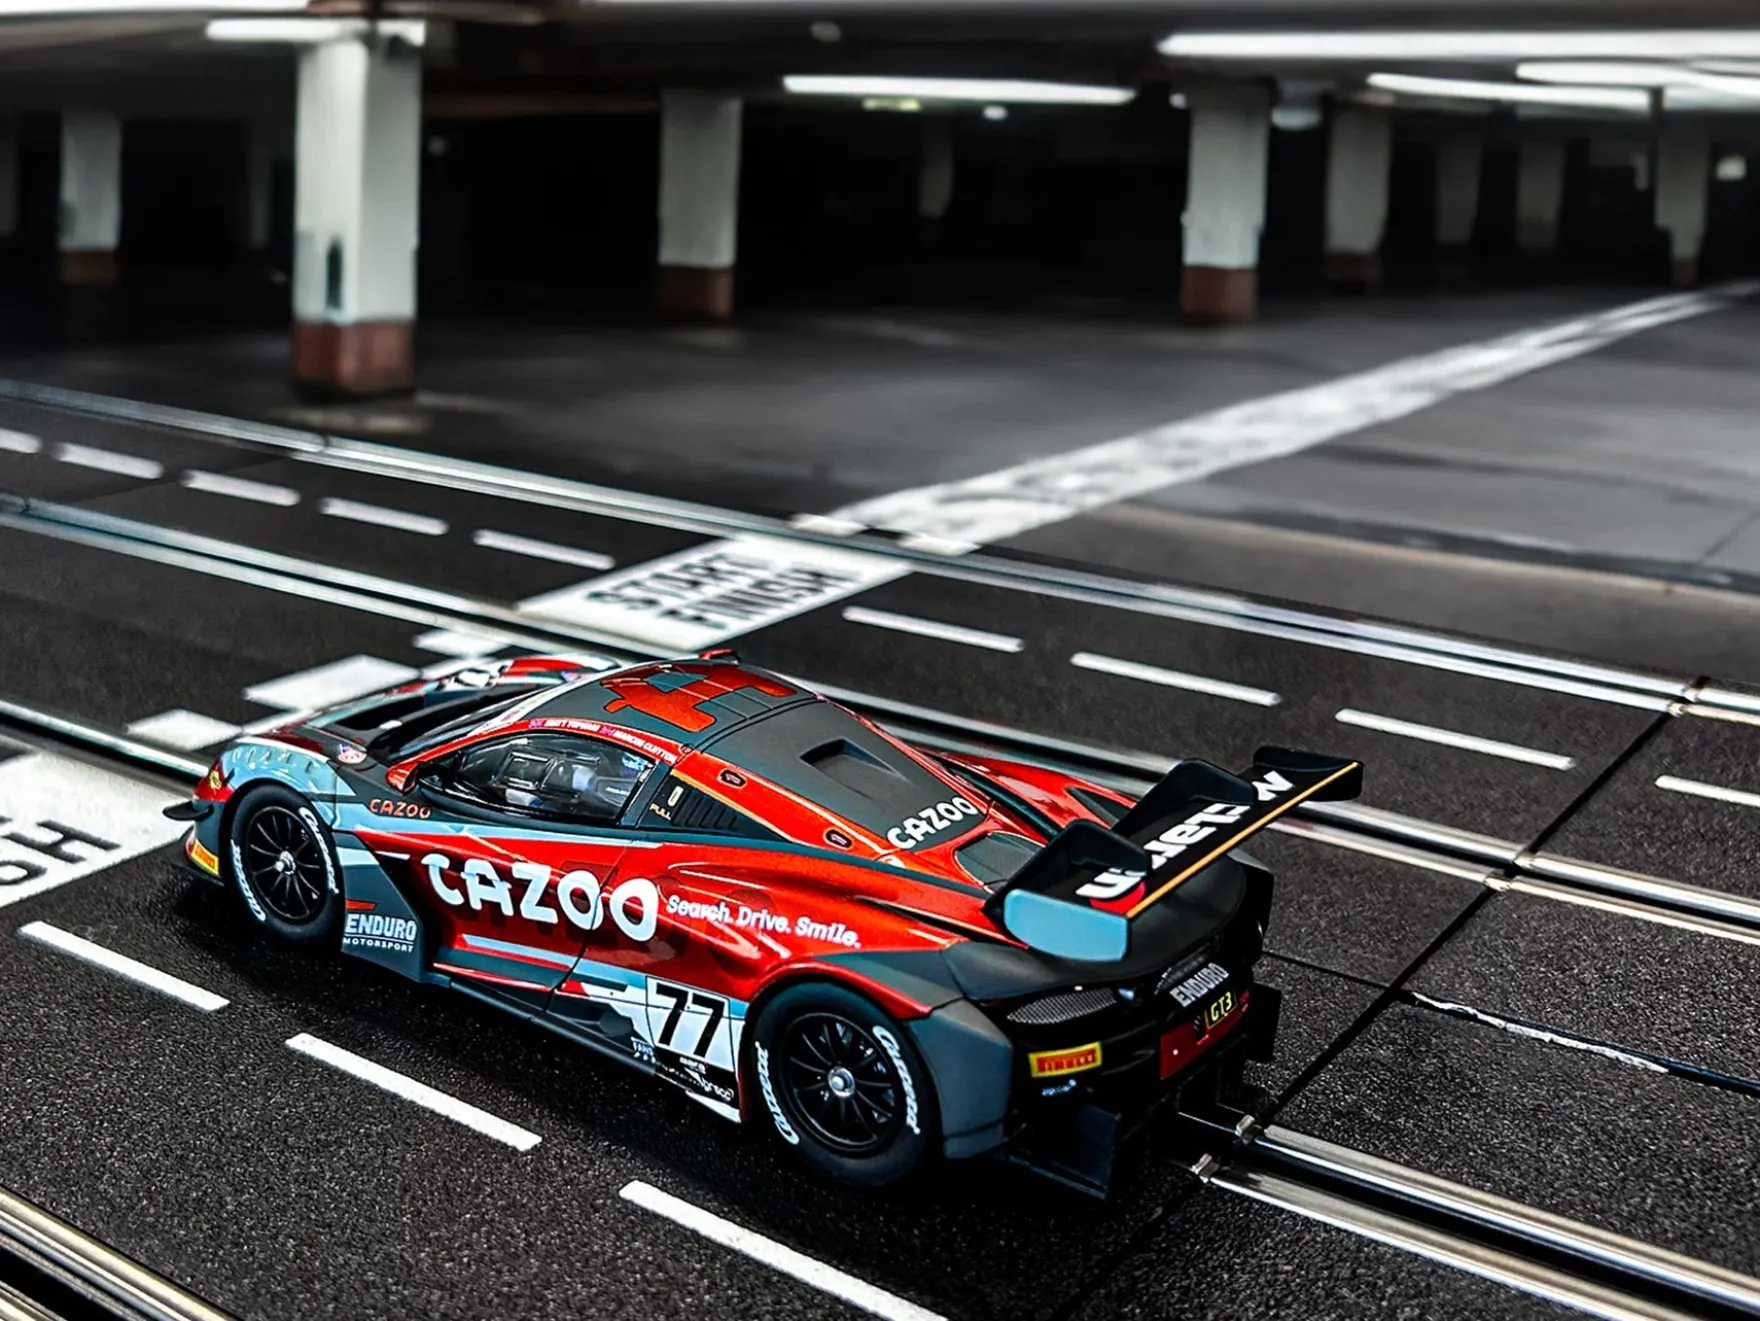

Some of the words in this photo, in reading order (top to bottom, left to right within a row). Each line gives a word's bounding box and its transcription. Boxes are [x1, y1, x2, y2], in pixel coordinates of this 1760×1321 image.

[586, 553, 774, 611] START
[656, 567, 862, 629] FINISH
[369, 798, 432, 819] CAZOO
[650, 803, 672, 821] PULL
[886, 796, 979, 850] CAZOO
[420, 852, 659, 942] CAZOO
[666, 894, 734, 926] Search.
[735, 905, 792, 935] Drive.
[794, 916, 862, 949] Smile.
[342, 936, 415, 953] MOTORSPORT
[345, 913, 418, 942] ENDURO
[1169, 962, 1230, 1008] ENDURO
[1210, 991, 1232, 1022] GT3
[655, 982, 726, 1058] 77
[754, 1041, 800, 1145] Carrera
[872, 1025, 921, 1135] Carrera
